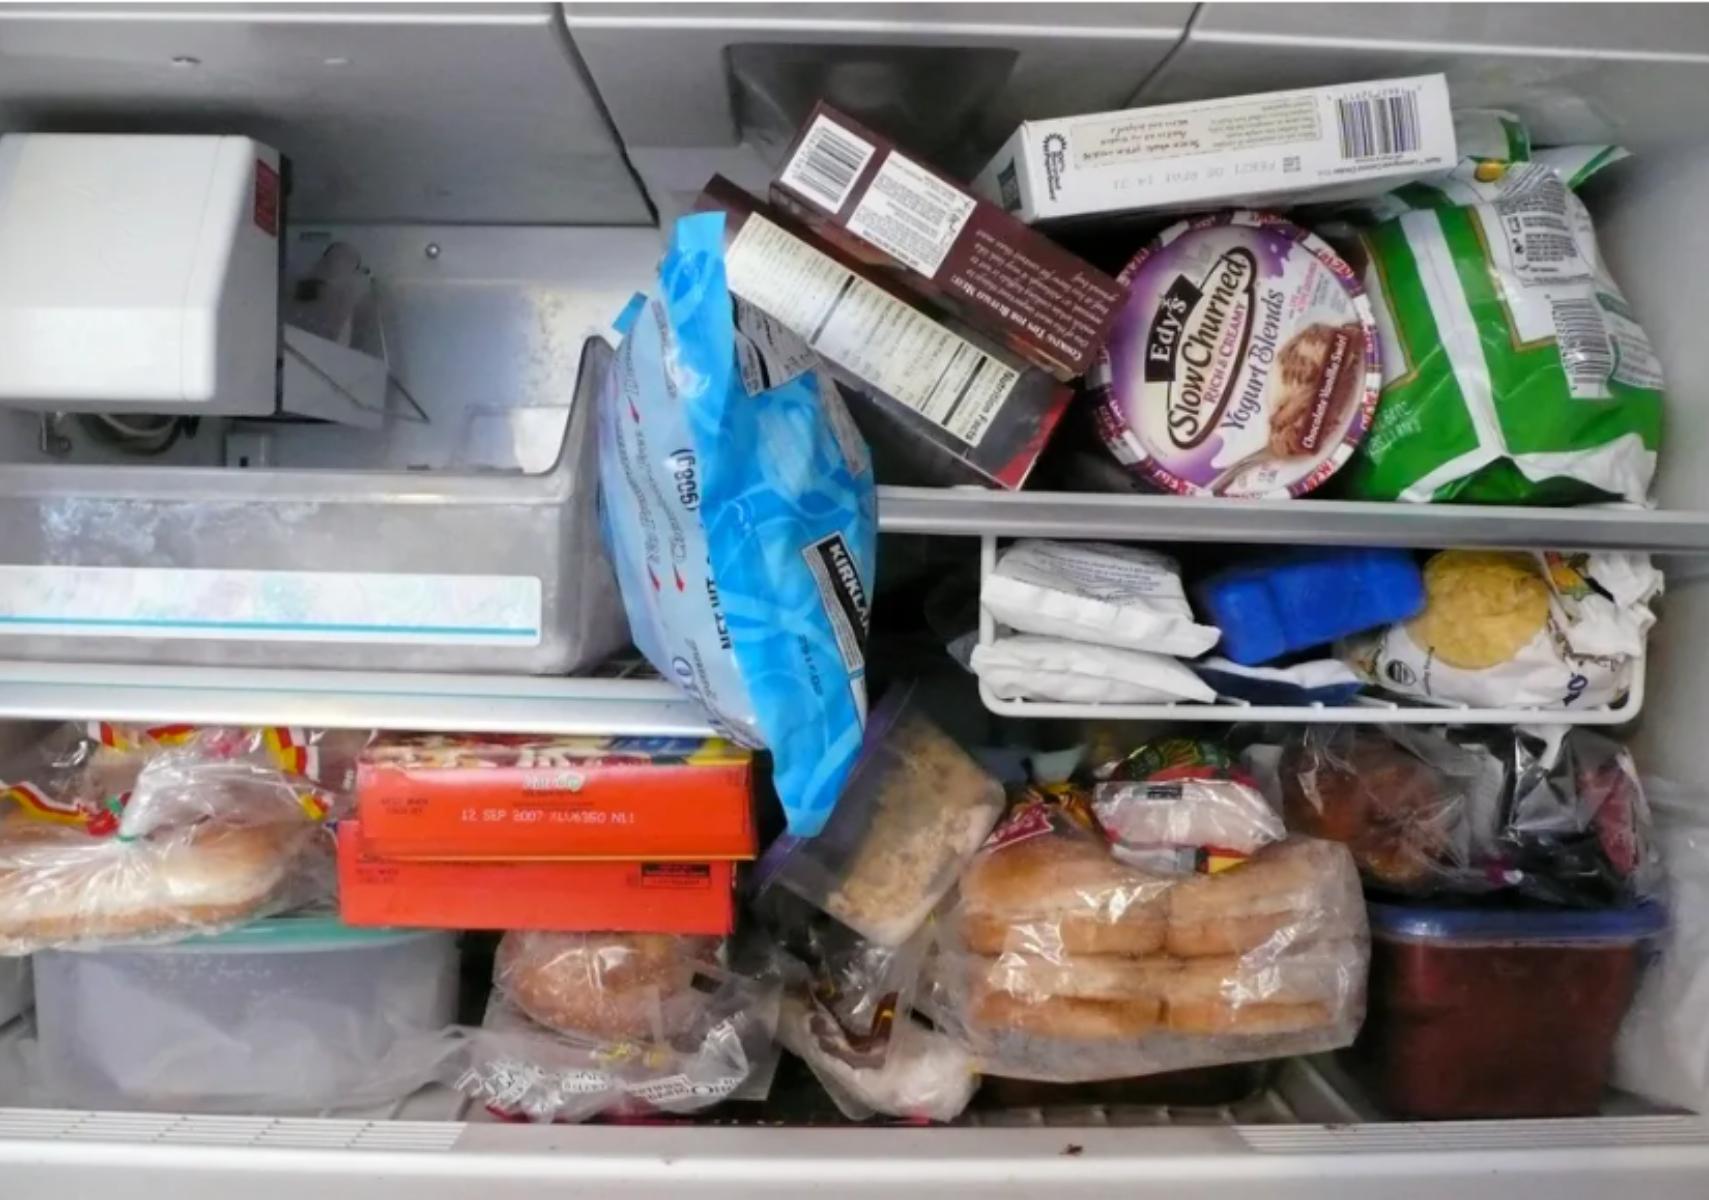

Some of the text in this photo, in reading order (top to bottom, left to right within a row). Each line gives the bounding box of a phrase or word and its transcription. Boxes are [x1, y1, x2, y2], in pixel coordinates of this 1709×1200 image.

[1150, 296, 1190, 363] Edy's
[1203, 368, 1226, 404] RICH
[1219, 303, 1246, 358] CREAMY
[1221, 365, 1268, 430] Yogurt
[1249, 289, 1285, 364] Blends
[965, 370, 1015, 441] Nutrition Facts
[1300, 397, 1329, 448] Chocolate
[670, 448, 699, 512] (908g)
[461, 808, 478, 822] 12
[483, 809, 507, 822] SEP
[512, 809, 545, 823] 2007
